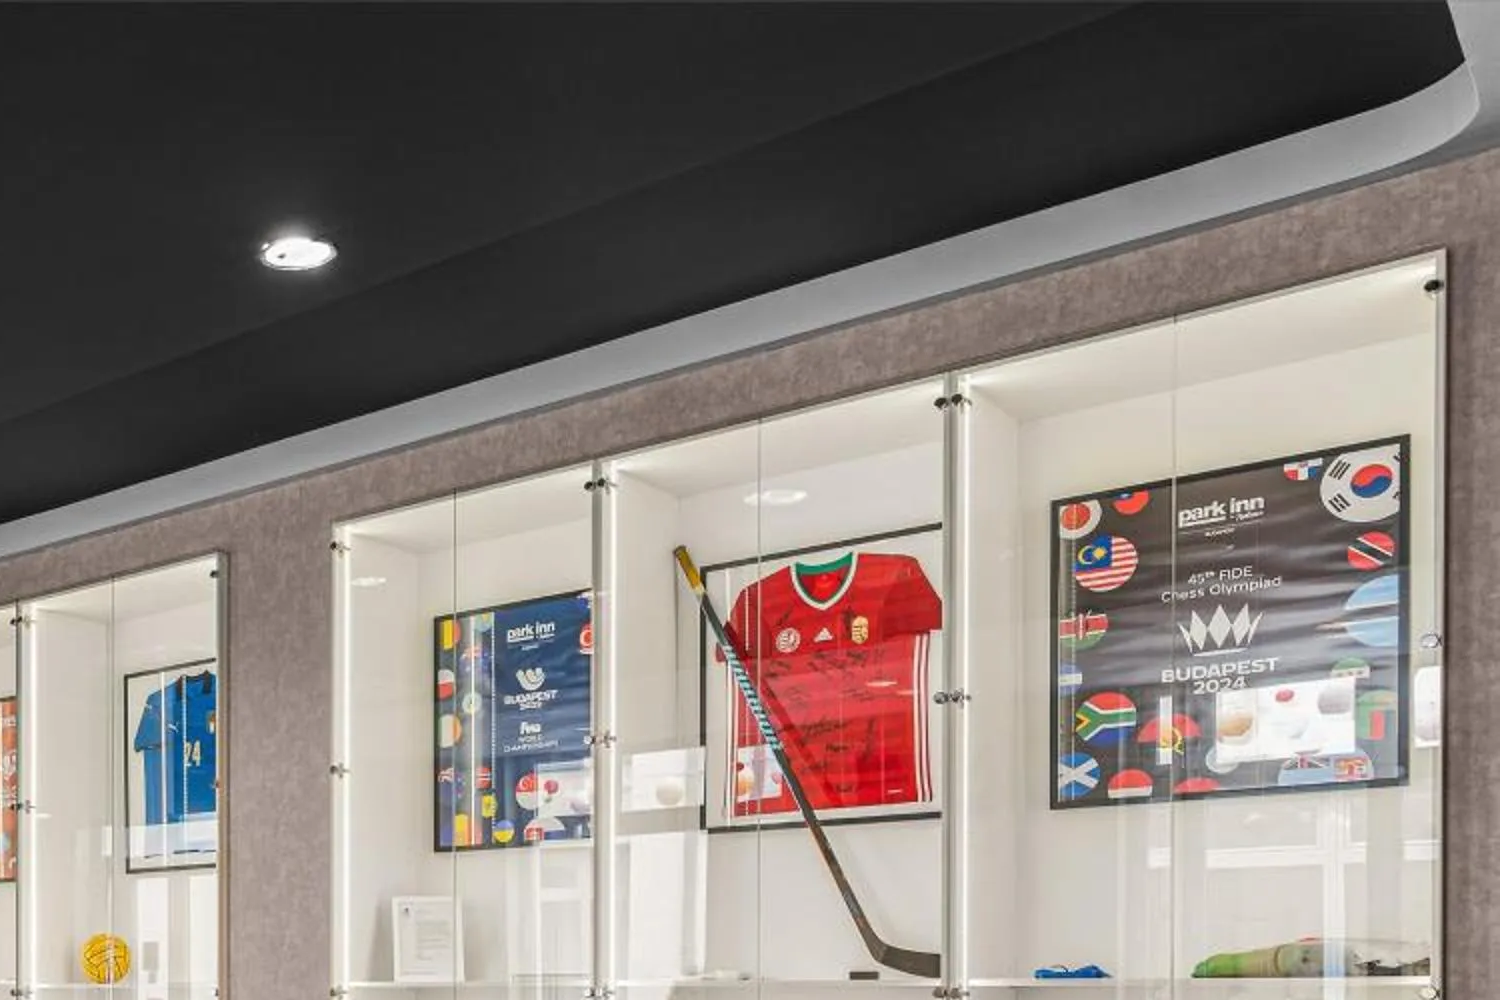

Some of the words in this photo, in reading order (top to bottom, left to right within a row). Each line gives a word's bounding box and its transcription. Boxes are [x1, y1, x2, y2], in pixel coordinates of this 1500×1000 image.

[1178, 500, 1226, 528] park
[1230, 497, 1264, 515] inn
[1219, 564, 1253, 580] FIDE
[1208, 575, 1282, 596] Olympiad
[507, 623, 534, 643] park
[535, 621, 555, 636] inn
[1160, 656, 1279, 683] BUDAPEST
[1192, 675, 1247, 695] 2024
[184, 740, 201, 767] 24
